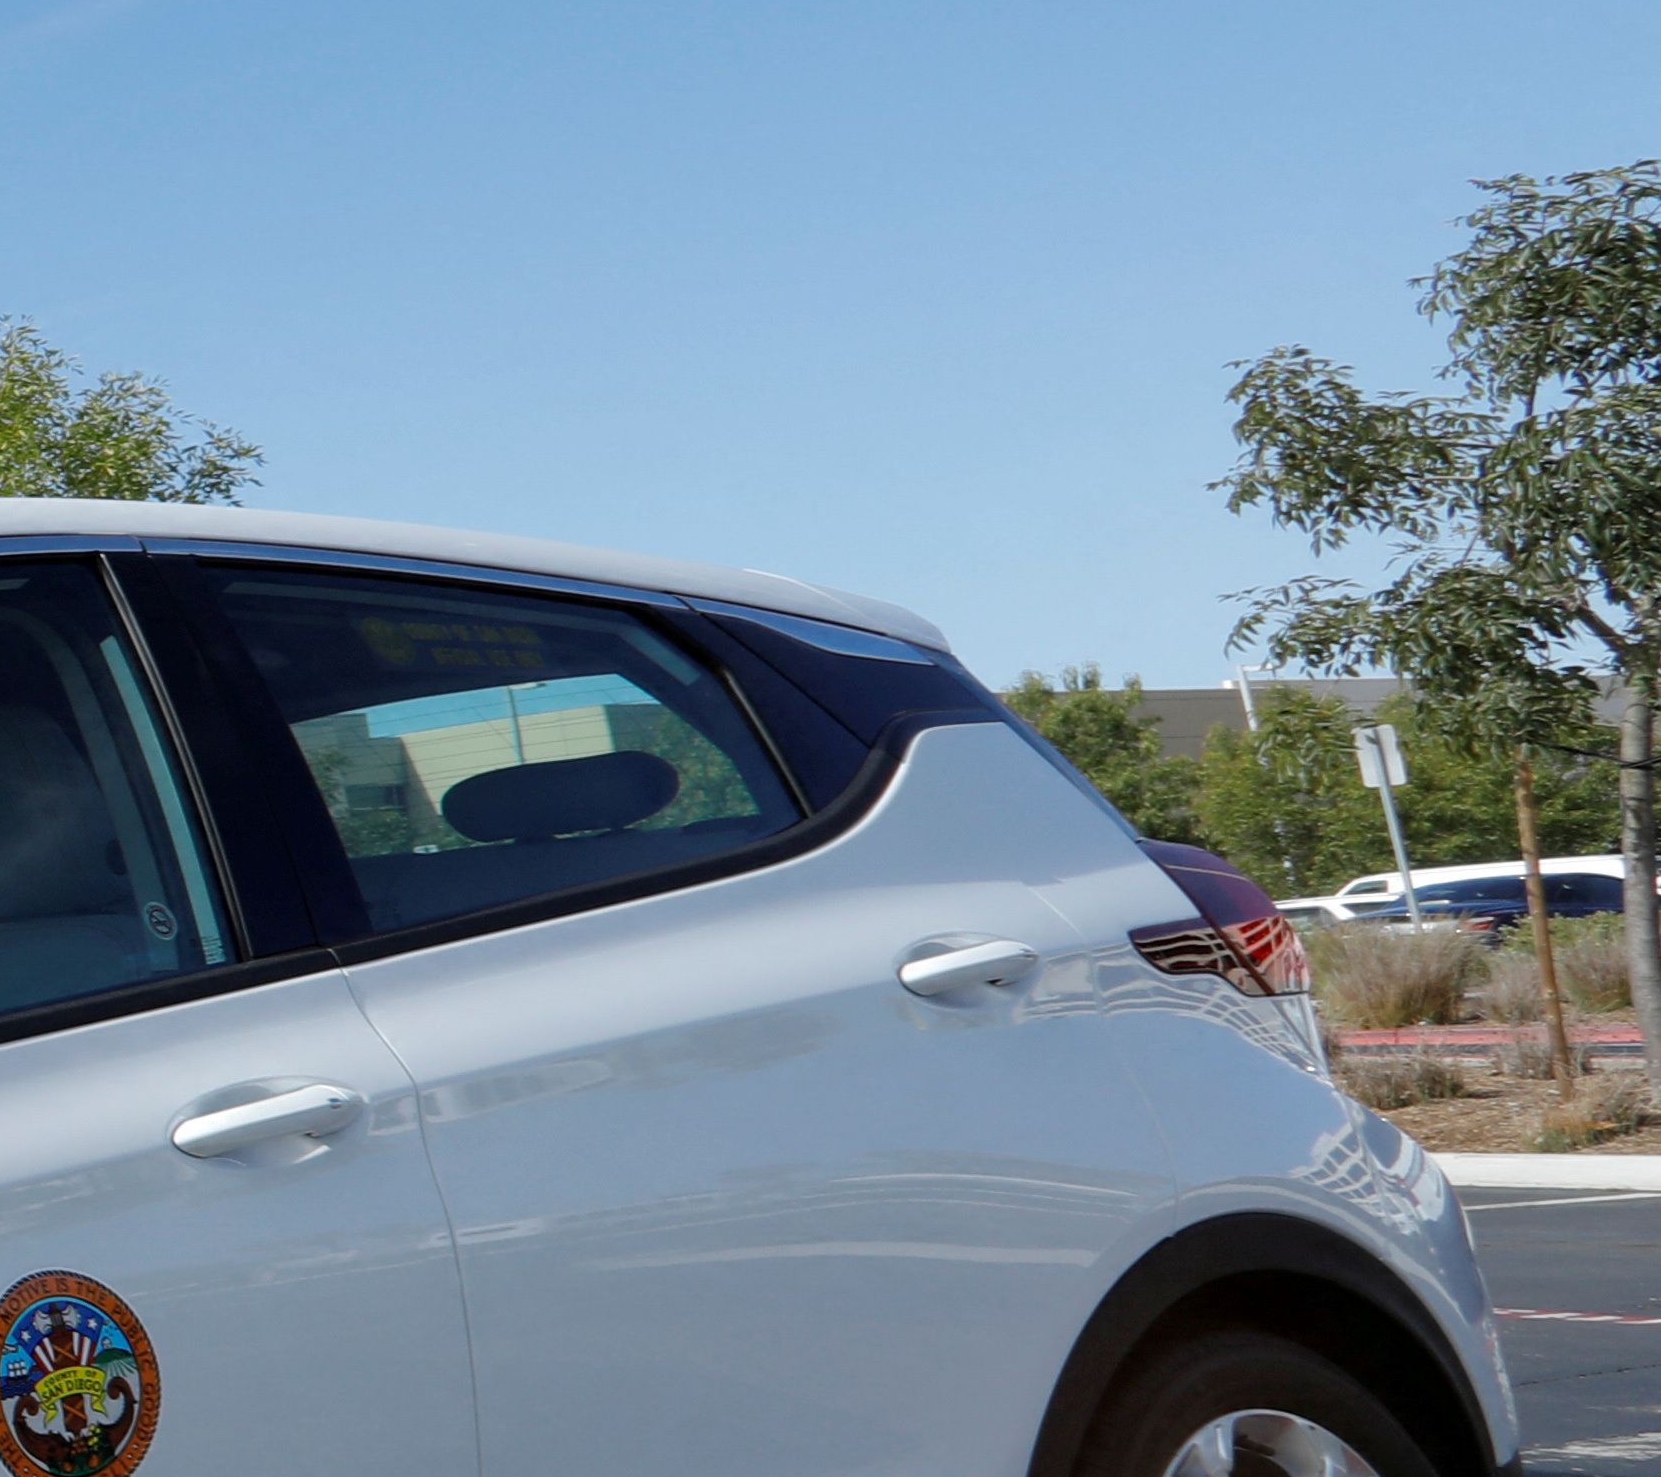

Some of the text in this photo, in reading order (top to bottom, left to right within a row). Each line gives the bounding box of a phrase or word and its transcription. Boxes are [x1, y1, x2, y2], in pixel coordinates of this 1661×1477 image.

[1, 1278, 49, 1323] MOTIVE
[55, 1277, 69, 1293] IS
[75, 1280, 107, 1306] THE
[42, 1378, 101, 1402] SAN DIEGO
